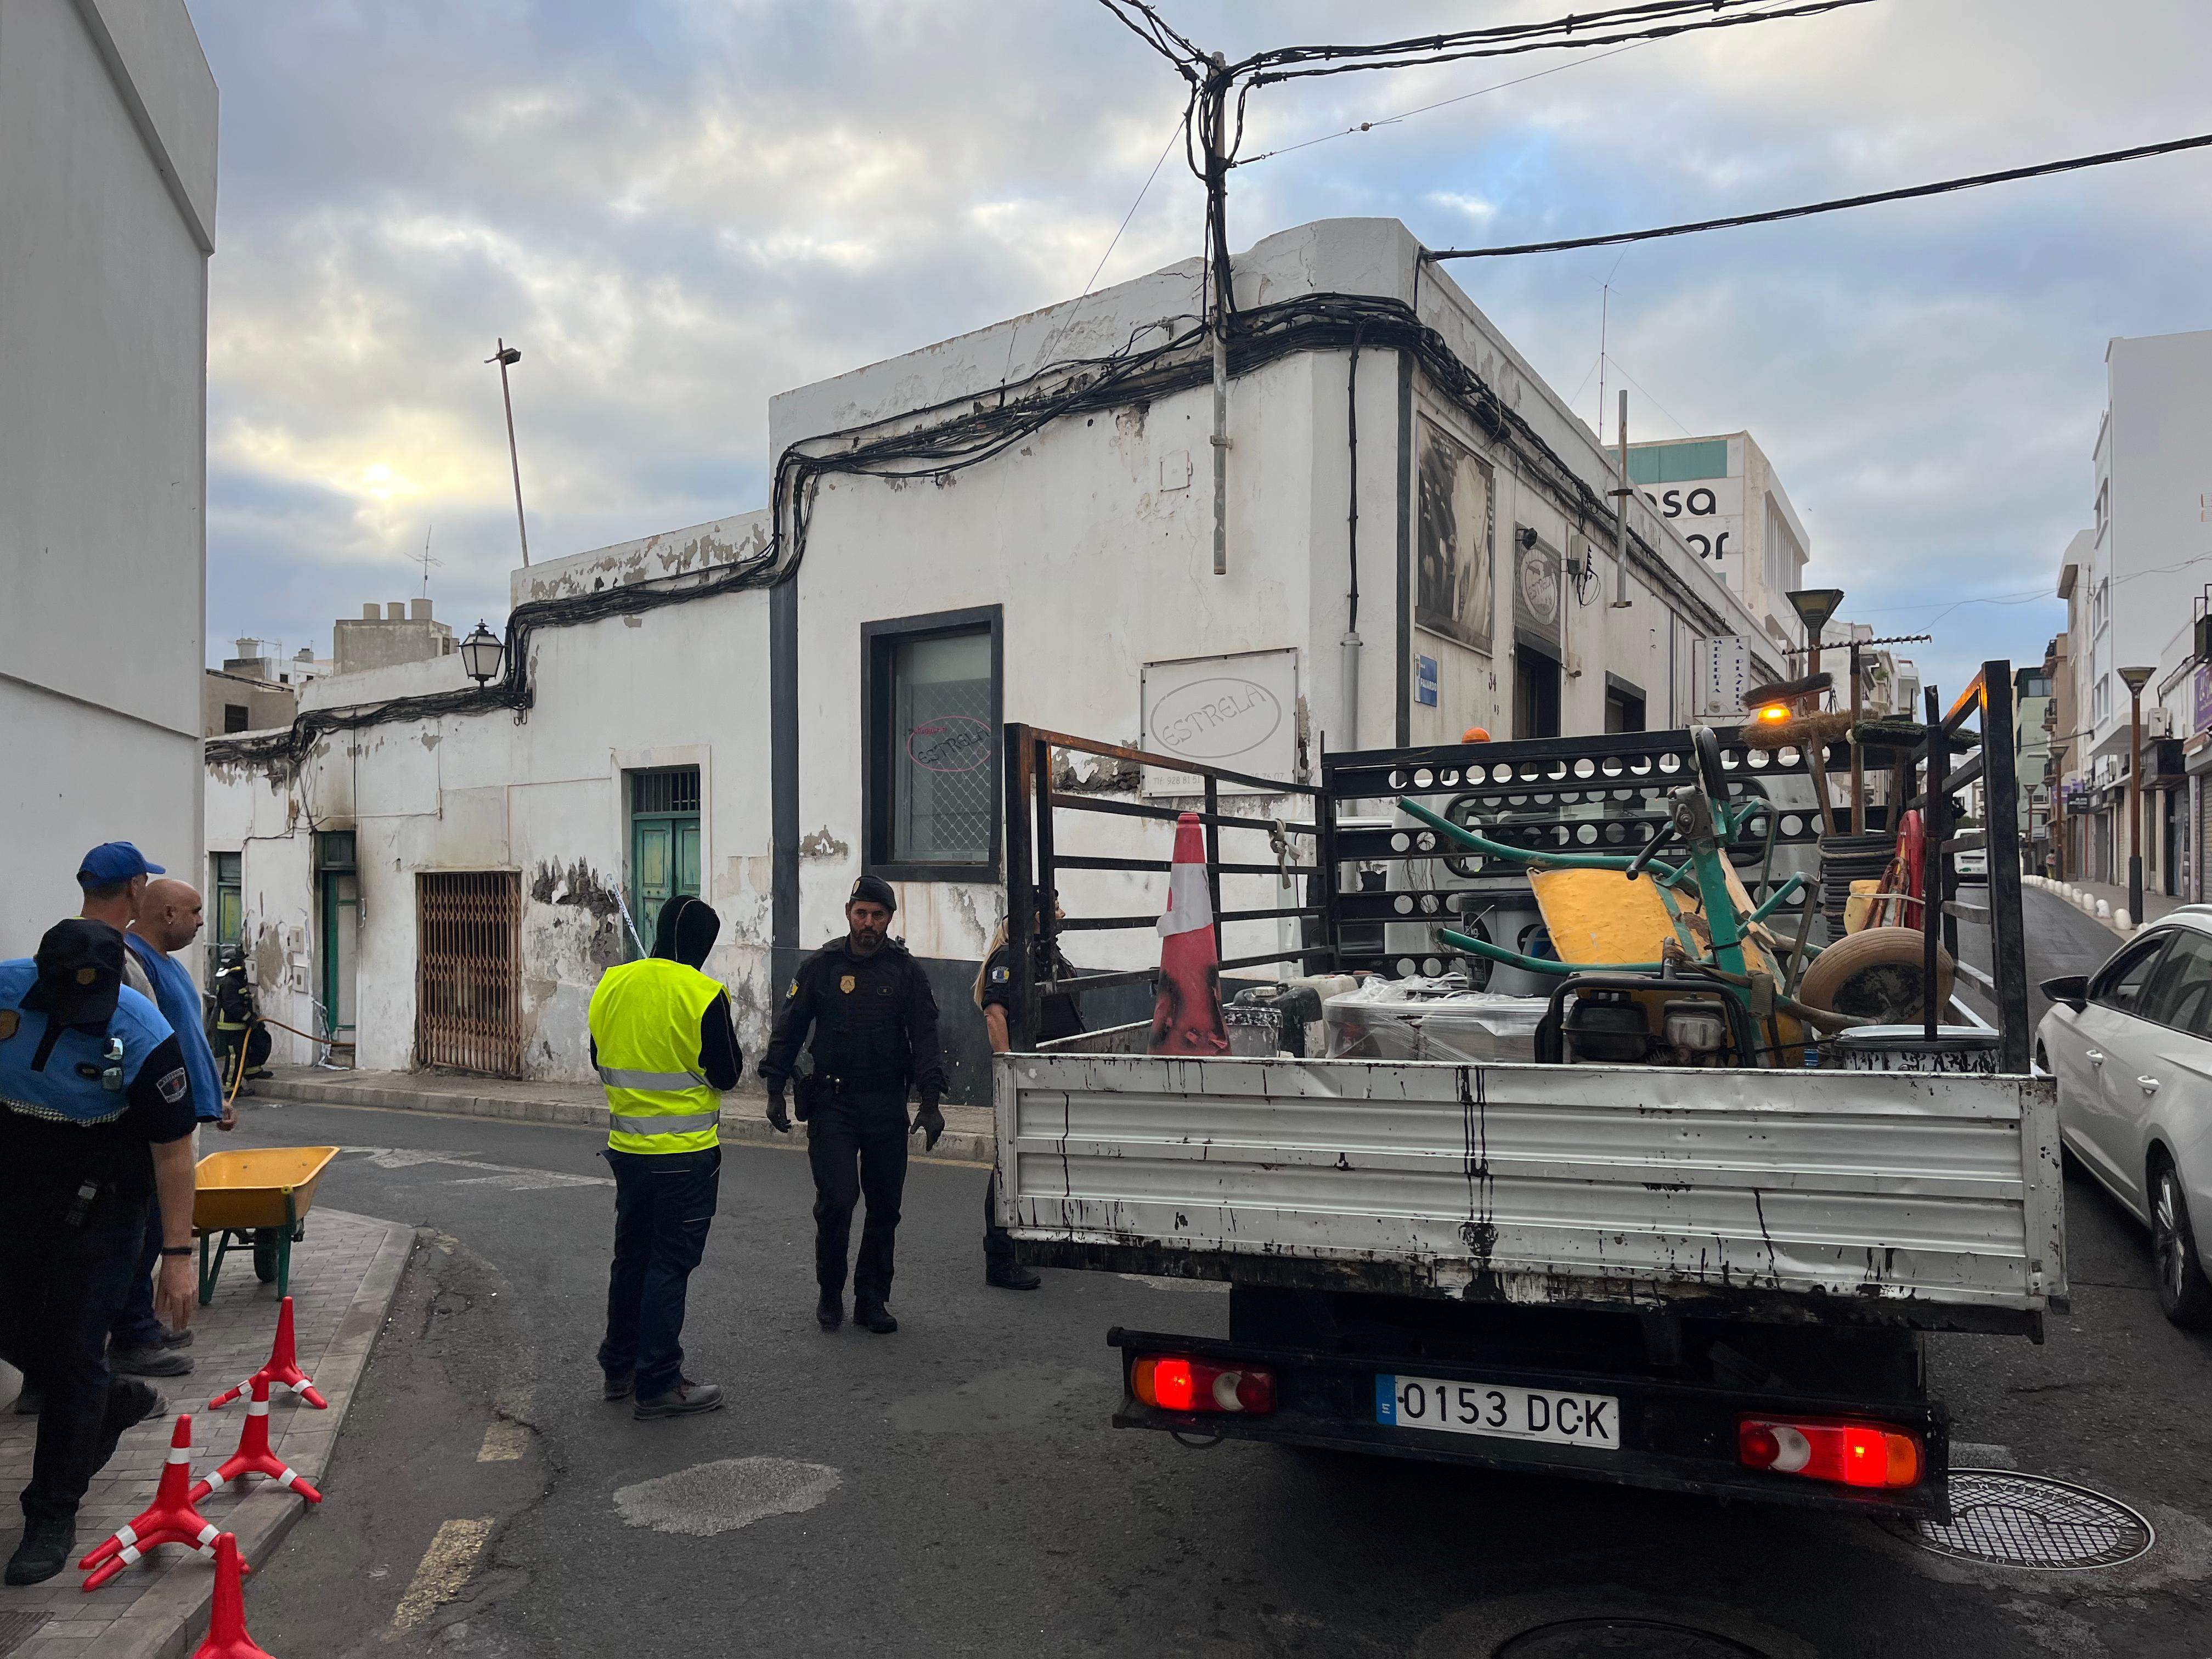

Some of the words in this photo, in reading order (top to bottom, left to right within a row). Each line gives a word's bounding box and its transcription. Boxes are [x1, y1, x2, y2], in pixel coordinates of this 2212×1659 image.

[1644, 488, 1716, 518] sa
[1420, 678, 1437, 692] FAJARDO
[1488, 672, 1497, 692] 34
[1163, 684, 1267, 746] ESTRELA
[918, 726, 990, 764] ESTRELA
[1167, 776, 1181, 785] 928
[1182, 776, 1190, 785] 81
[1192, 775, 1201, 784] 51
[1273, 772, 1285, 781] 07
[1403, 1383, 1508, 1427] 0153
[1527, 1393, 1610, 1440] DCK
